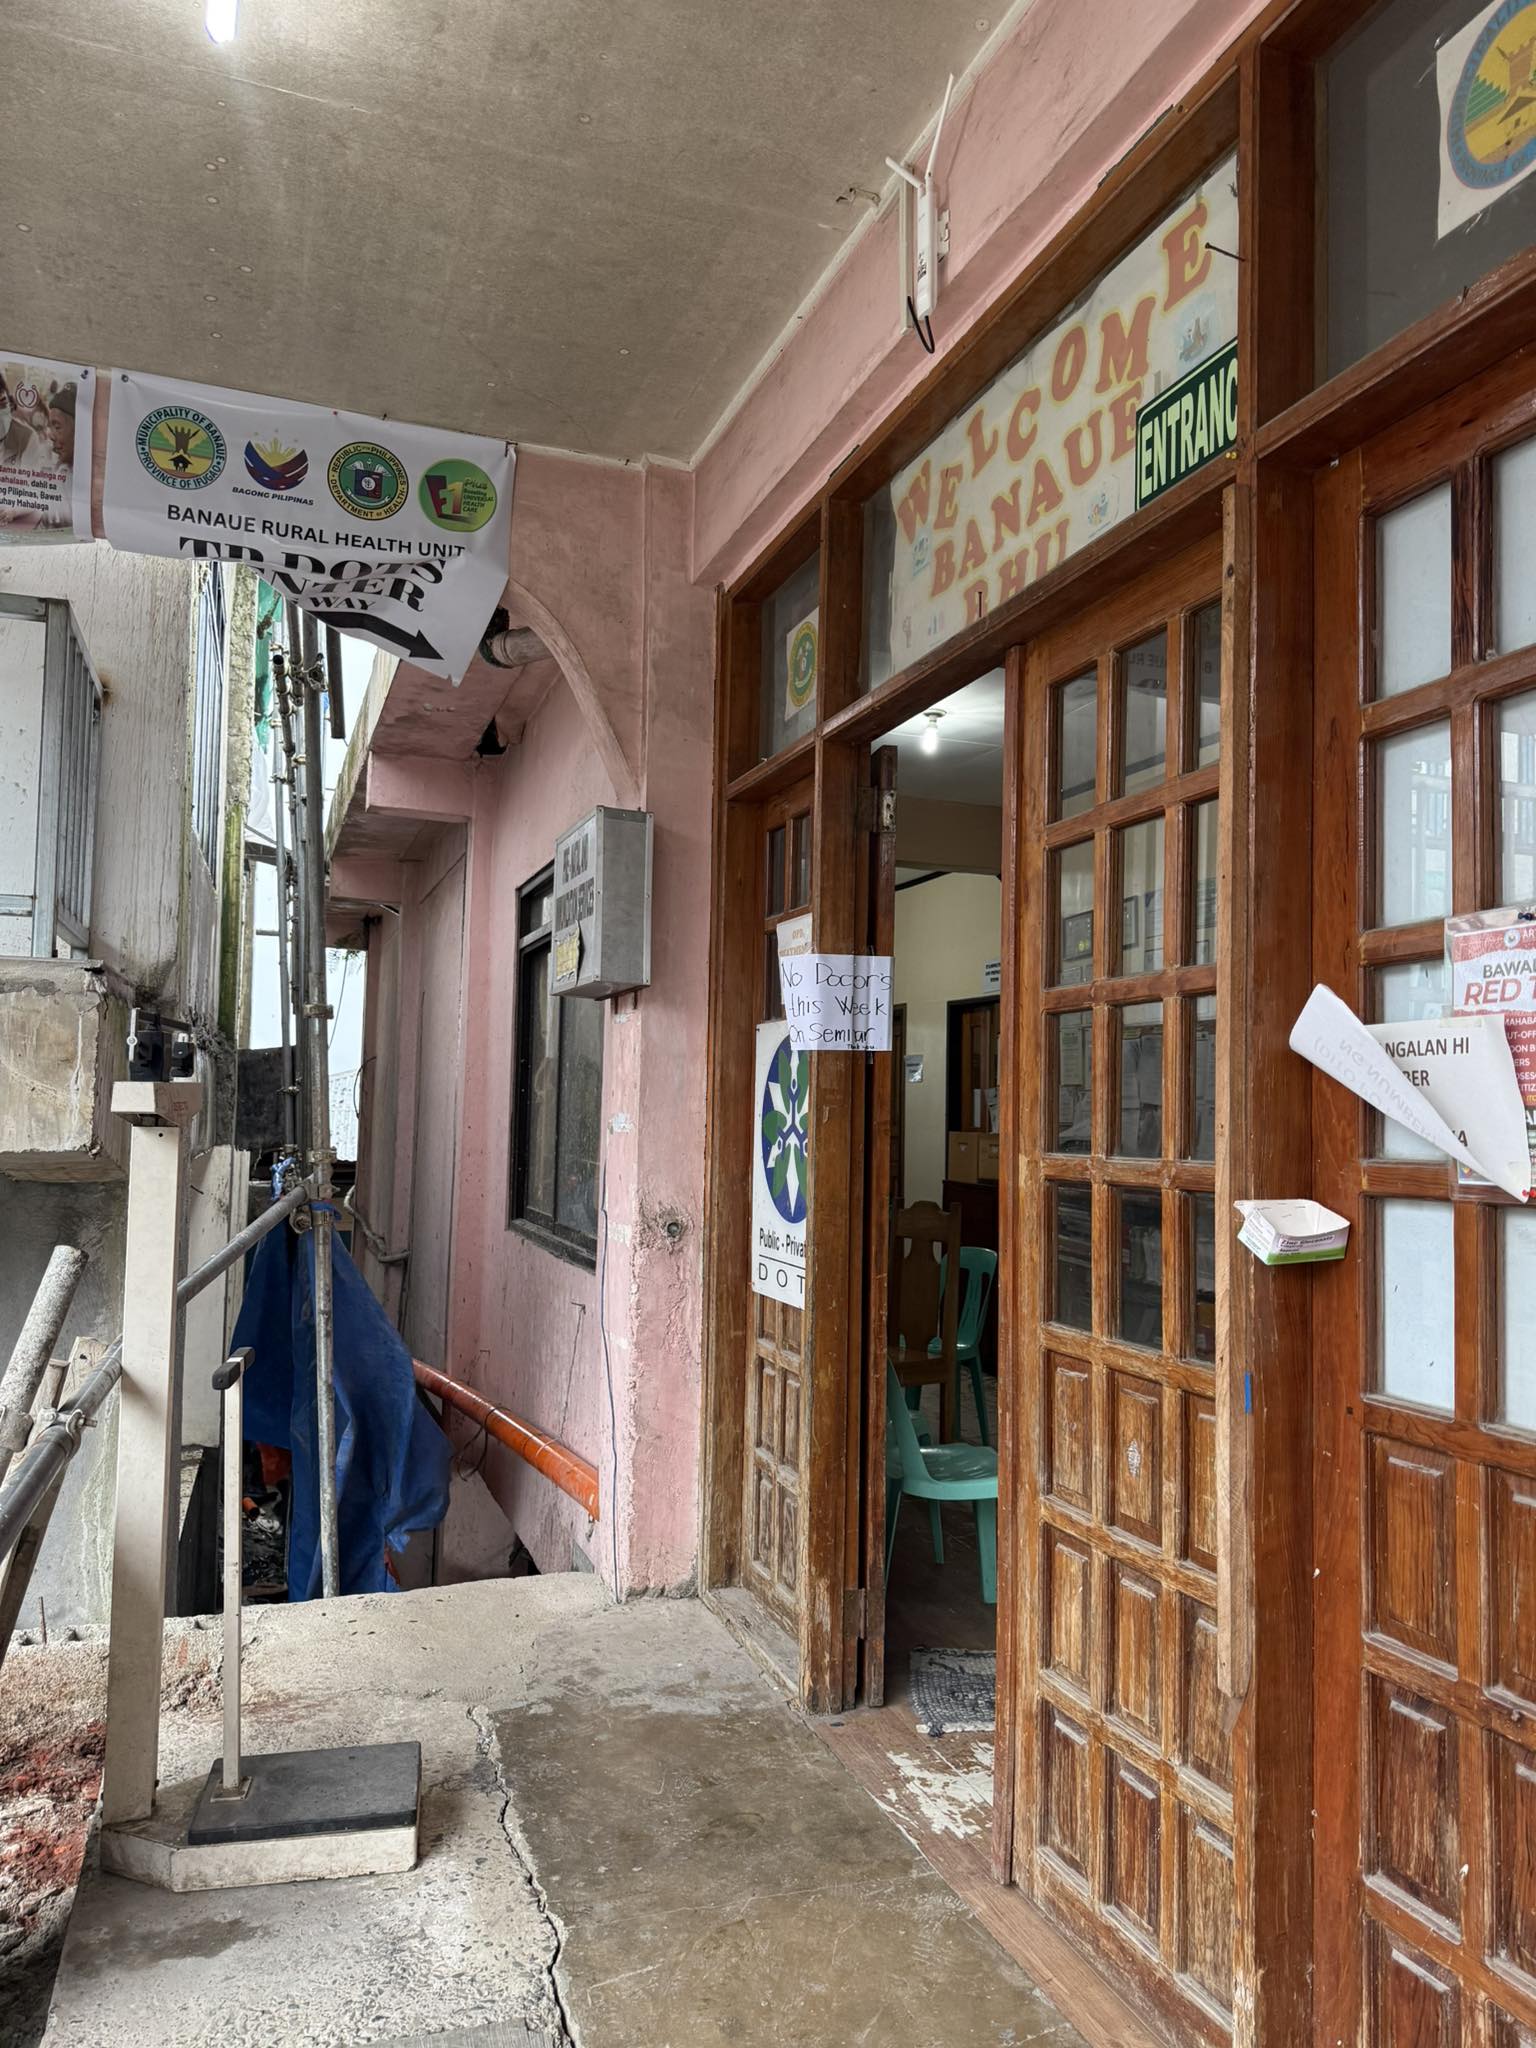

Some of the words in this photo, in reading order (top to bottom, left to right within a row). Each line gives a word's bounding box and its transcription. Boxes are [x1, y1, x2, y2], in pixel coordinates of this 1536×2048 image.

[897, 203, 1212, 545] WELCOME
[137, 408, 189, 447] MUNICIPALITY
[192, 411, 207, 426] OF
[205, 422, 225, 463] BANAUE
[1141, 358, 1238, 500] ENTRANC
[141, 451, 177, 488] PROVINCE
[179, 480, 192, 489] OF
[194, 464, 221, 488] IFUGAO
[331, 445, 361, 473] REPUBLIC
[371, 447, 407, 487] PHILIPPINES
[0, 476, 30, 487] ahalaan,
[931, 384, 1140, 597] BANAUE
[17, 499, 49, 511] Mahalaga
[40, 491, 62, 502] Bawat
[232, 486, 270, 499] BAGONG
[271, 493, 314, 506] PILIPINAS
[330, 479, 374, 518] DEPARTMENT
[384, 488, 407, 517] HEALTH
[167, 504, 256, 533] BANAUE
[261, 520, 329, 544] RURAL
[336, 531, 412, 553] HEALTH
[418, 542, 466, 558] UNIT
[310, 596, 377, 610] WAY
[782, 962, 803, 987] No
[1464, 978, 1522, 1006] RED
[789, 993, 823, 1017] this
[835, 995, 887, 1016] Week
[790, 1025, 805, 1043] On
[1507, 1030, 1536, 1040] UT-OFF
[1382, 1038, 1447, 1058] NGALAN
[1453, 1036, 1469, 1054] HI
[760, 1228, 780, 1251] Public
